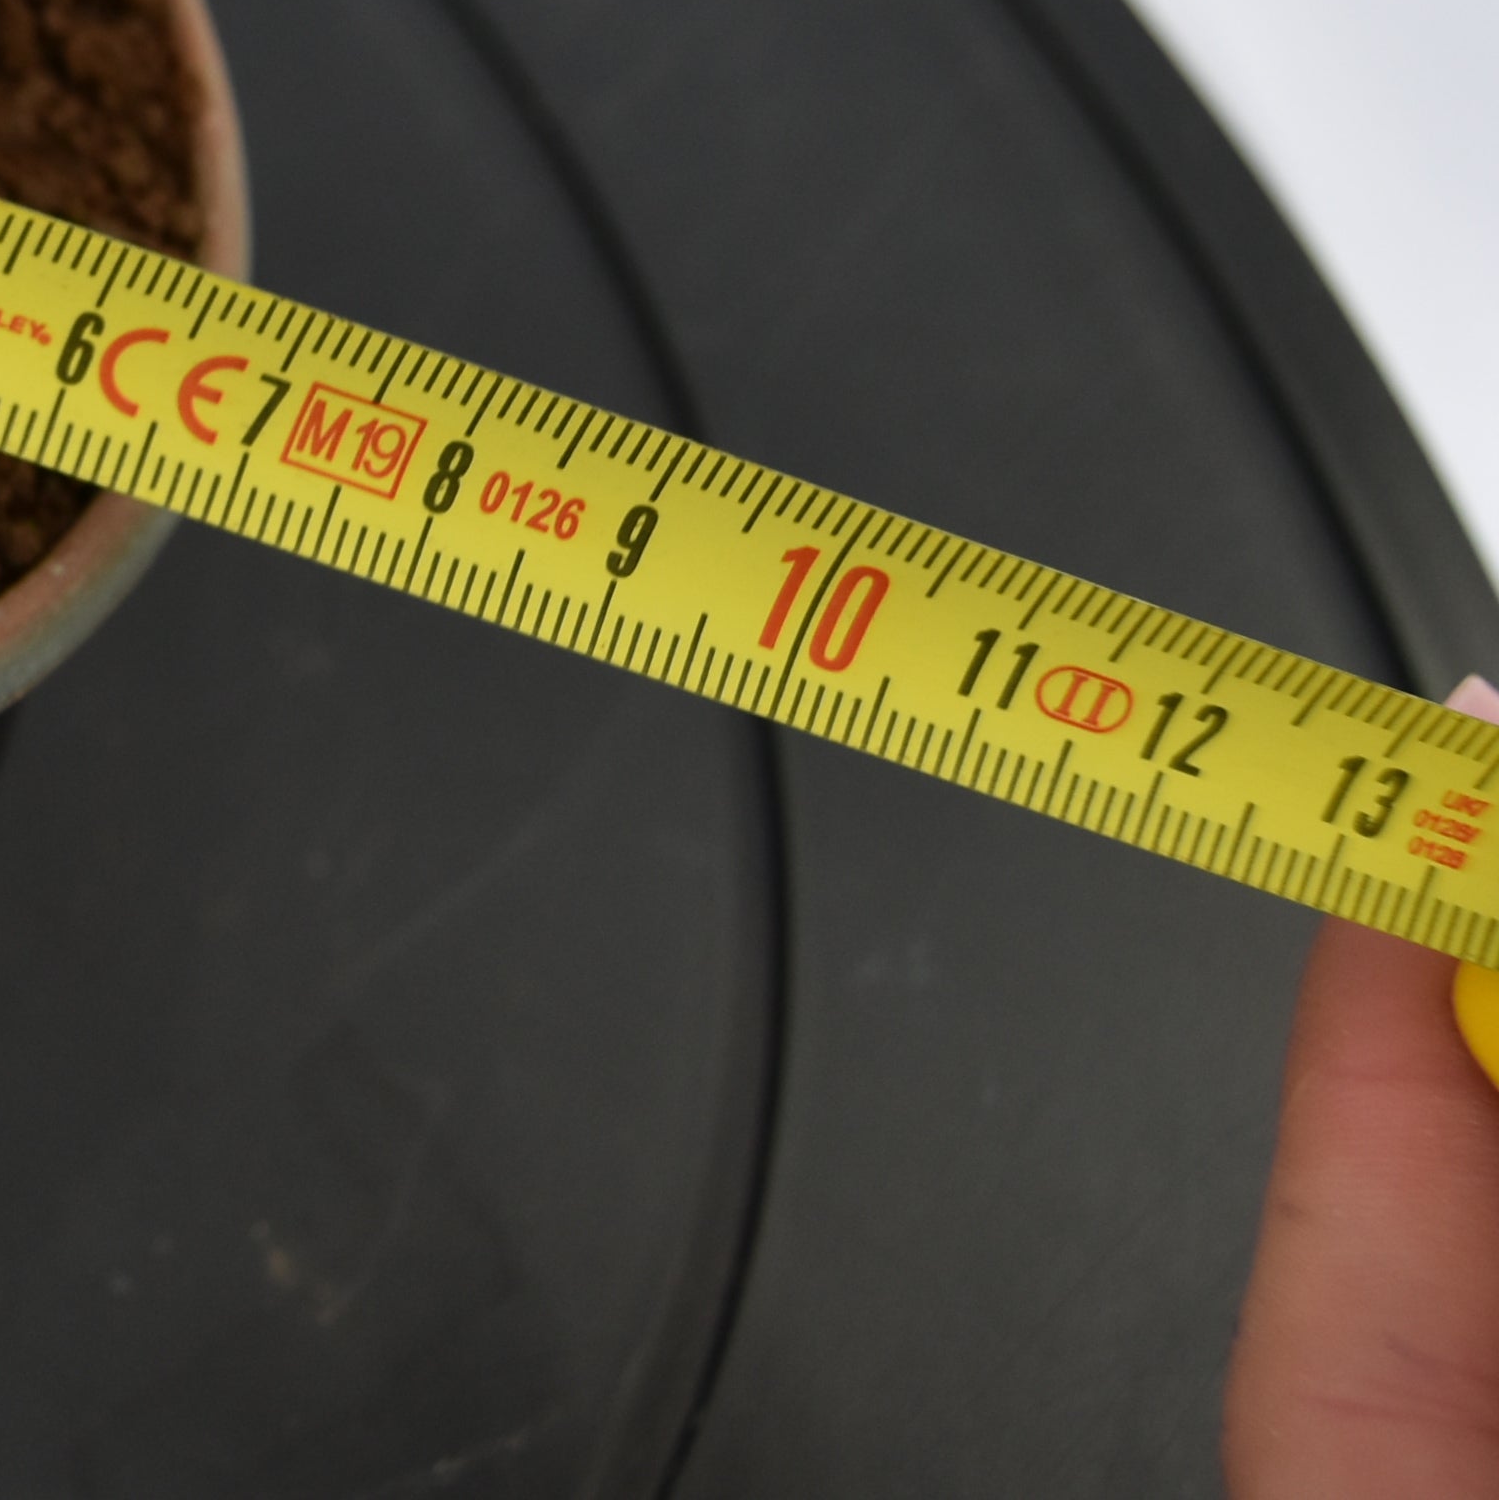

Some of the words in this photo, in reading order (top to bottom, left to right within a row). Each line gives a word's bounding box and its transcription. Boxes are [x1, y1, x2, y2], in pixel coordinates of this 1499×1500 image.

[54, 311, 105, 386] 6
[239, 373, 292, 447] 7
[422, 440, 474, 515] 8
[479, 470, 587, 541] 0126
[605, 503, 660, 579] 9
[757, 545, 891, 672] 10
[957, 628, 1040, 710] 11
[1140, 692, 1229, 777] 12
[1321, 755, 1410, 839] 13
